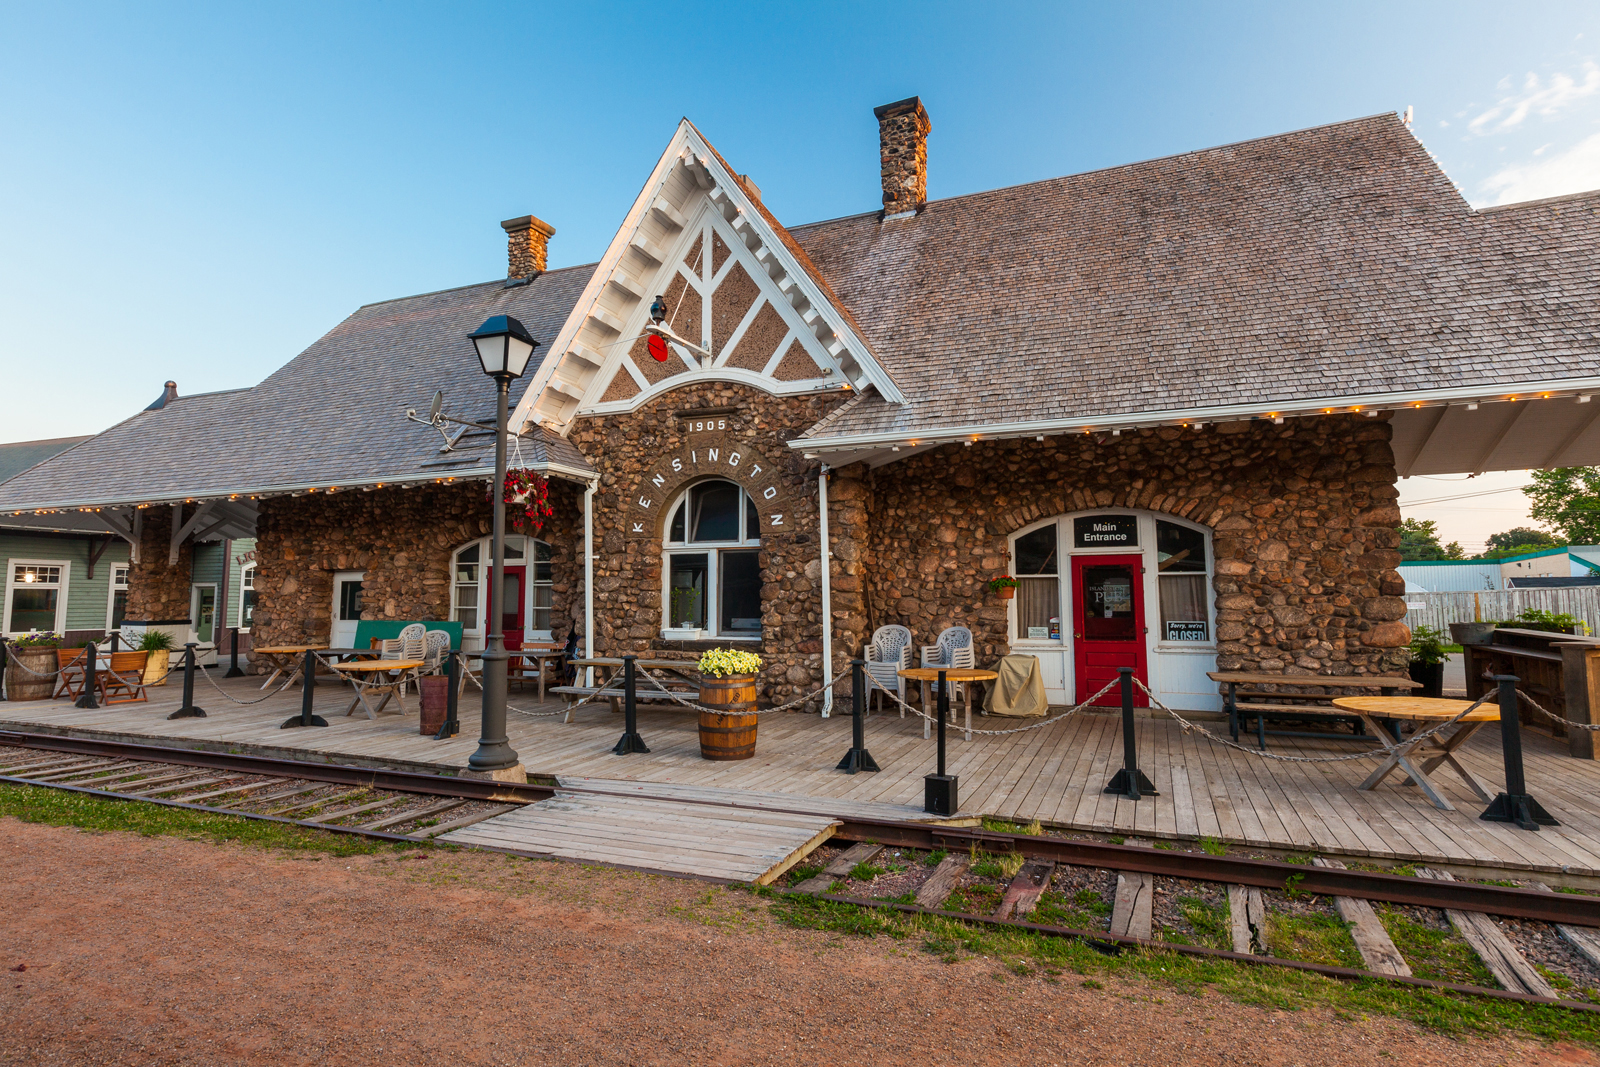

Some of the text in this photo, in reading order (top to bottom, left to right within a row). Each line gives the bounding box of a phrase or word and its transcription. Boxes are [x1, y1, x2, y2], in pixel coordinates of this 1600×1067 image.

[690, 420, 725, 432] 1905
[633, 448, 783, 532] KENSINGTON
[1093, 523, 1117, 532] Main
[1084, 533, 1127, 541] Entrance
[1094, 591, 1123, 602] PUB
[1169, 630, 1204, 640] CLOSED
